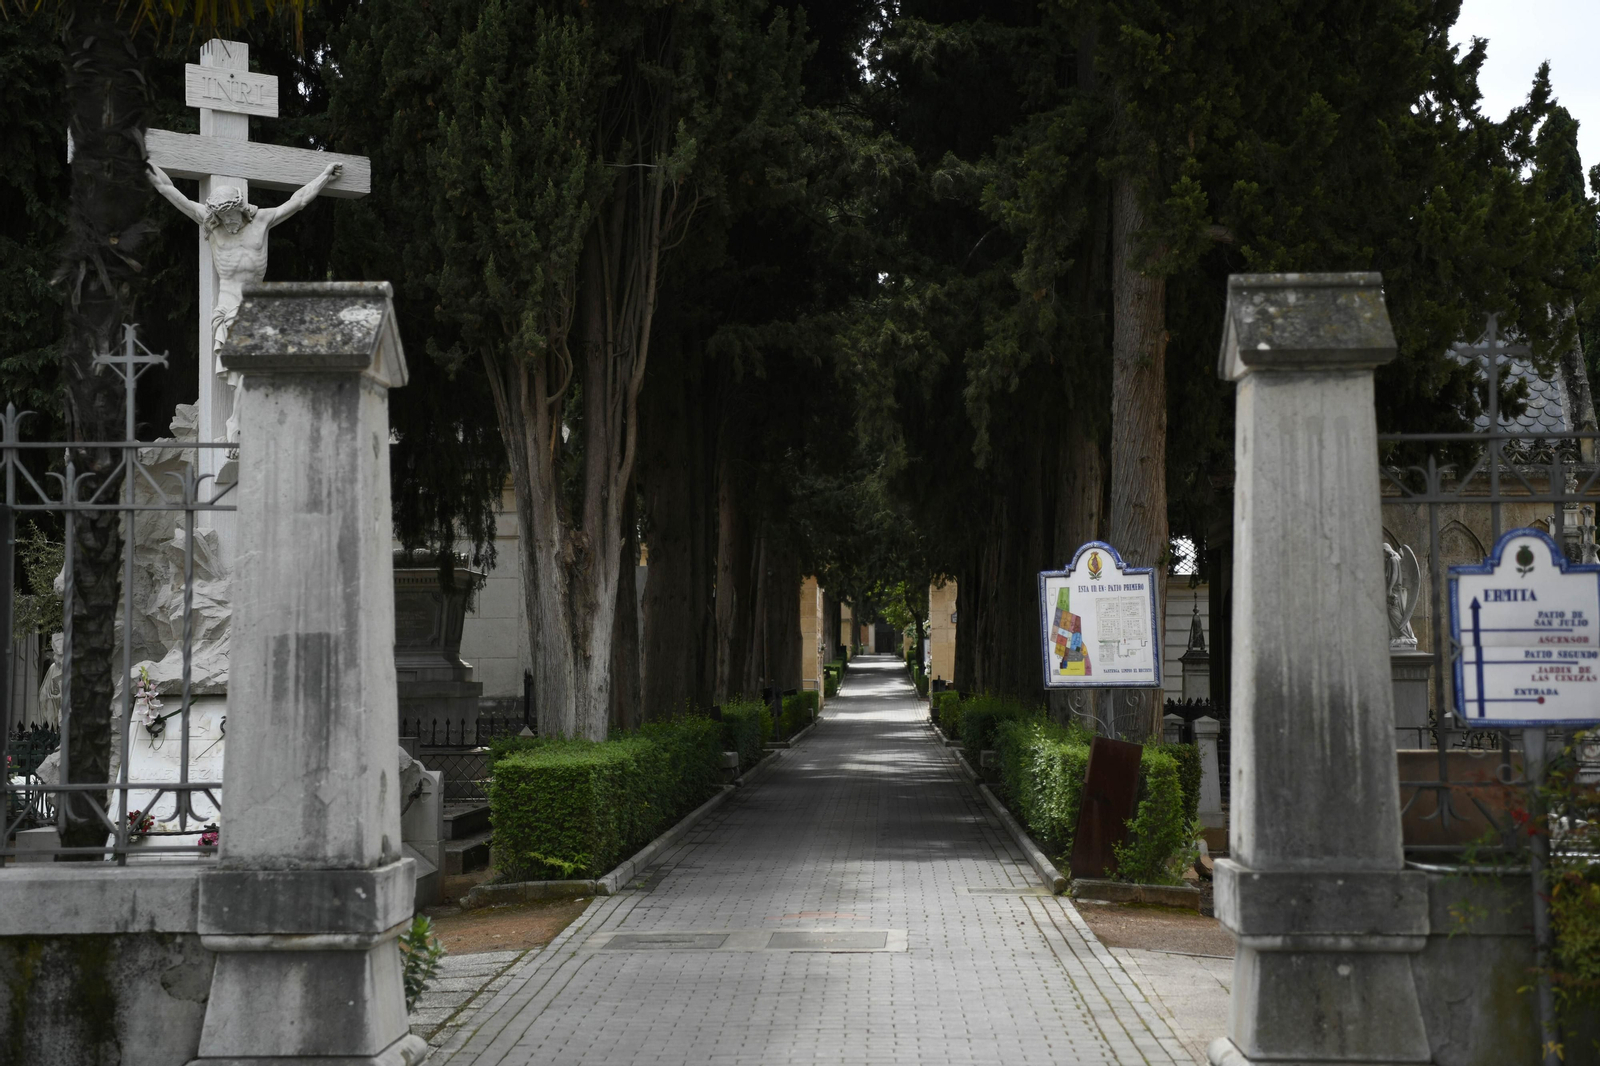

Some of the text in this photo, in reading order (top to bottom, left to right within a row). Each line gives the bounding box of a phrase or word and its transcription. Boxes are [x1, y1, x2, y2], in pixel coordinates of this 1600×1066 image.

[202, 77, 264, 106] INRI
[1078, 585, 1090, 593] ESTA
[1108, 584, 1122, 592] PATIO
[1123, 583, 1144, 591] PRIMERO
[1483, 589, 1537, 602] ERMITA
[1538, 611, 1583, 619] PATIO DE
[1534, 619, 1588, 627] SAN JULIO
[1538, 636, 1589, 644] ASCENSOR
[1524, 650, 1598, 659] PATIO SEGUNDO
[1536, 666, 1591, 674] JARDIN DE
[1531, 674, 1597, 682] LAS CENIZAS
[1514, 688, 1559, 696] ENTRADA
